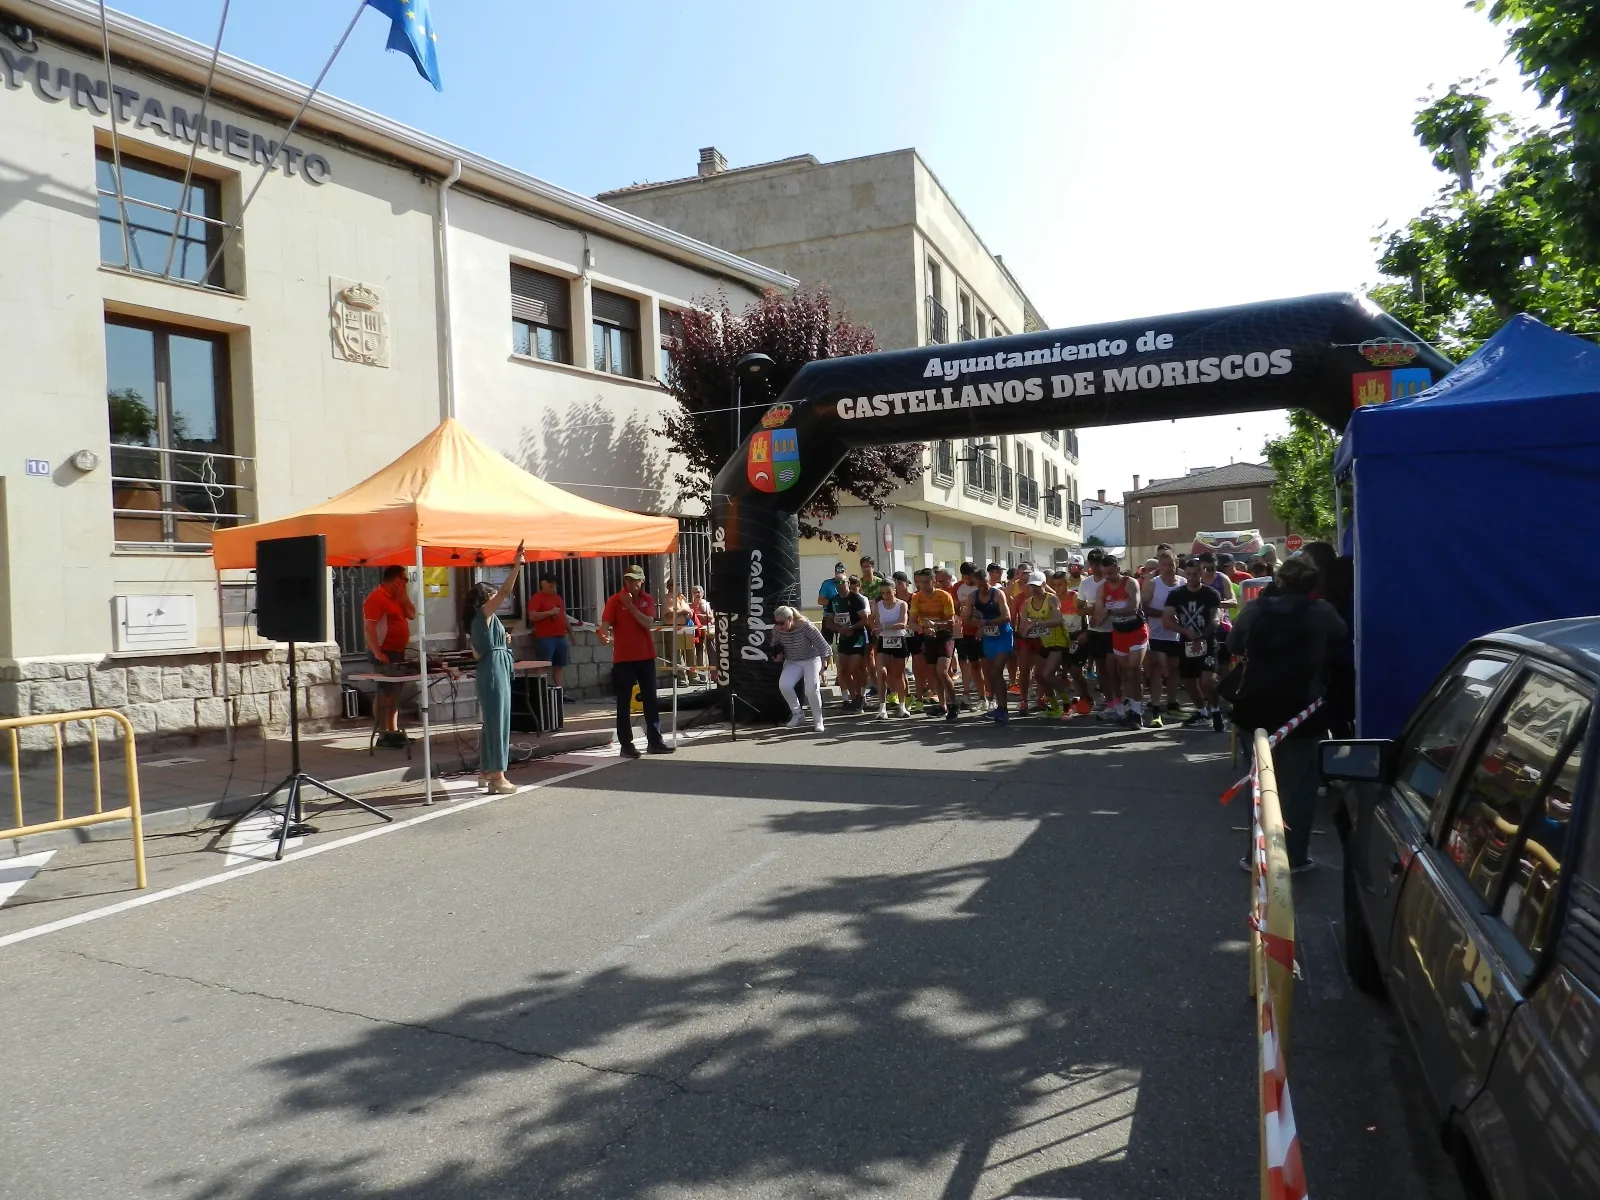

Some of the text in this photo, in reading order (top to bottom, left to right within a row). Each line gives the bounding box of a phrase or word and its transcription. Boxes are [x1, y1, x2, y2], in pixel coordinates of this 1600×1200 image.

[0, 47, 331, 185] YUNTAMIENTO
[836, 348, 1293, 420] CASTELLANOS DE MORISCOS
[923, 330, 1174, 381] Ayuntamiento de
[29, 461, 49, 474] 10
